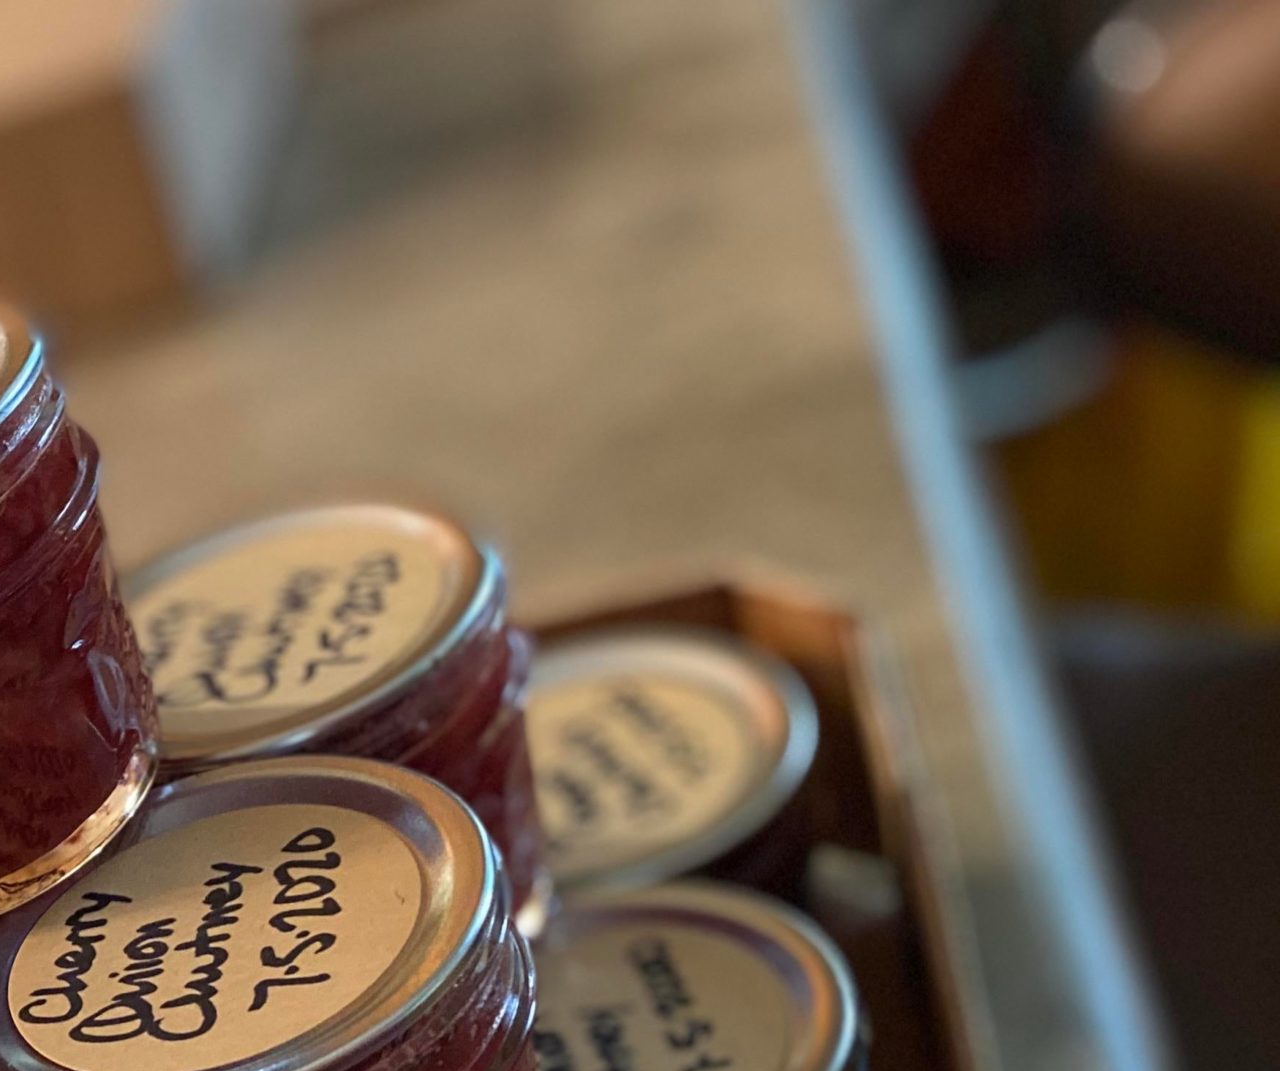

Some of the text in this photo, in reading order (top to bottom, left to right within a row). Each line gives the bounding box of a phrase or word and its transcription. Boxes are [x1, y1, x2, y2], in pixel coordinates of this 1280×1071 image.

[19, 892, 132, 1023] Cherry
[69, 918, 176, 1042] Onion
[148, 862, 263, 1040] Chutney
[248, 827, 342, 1012] 7.5.2020
